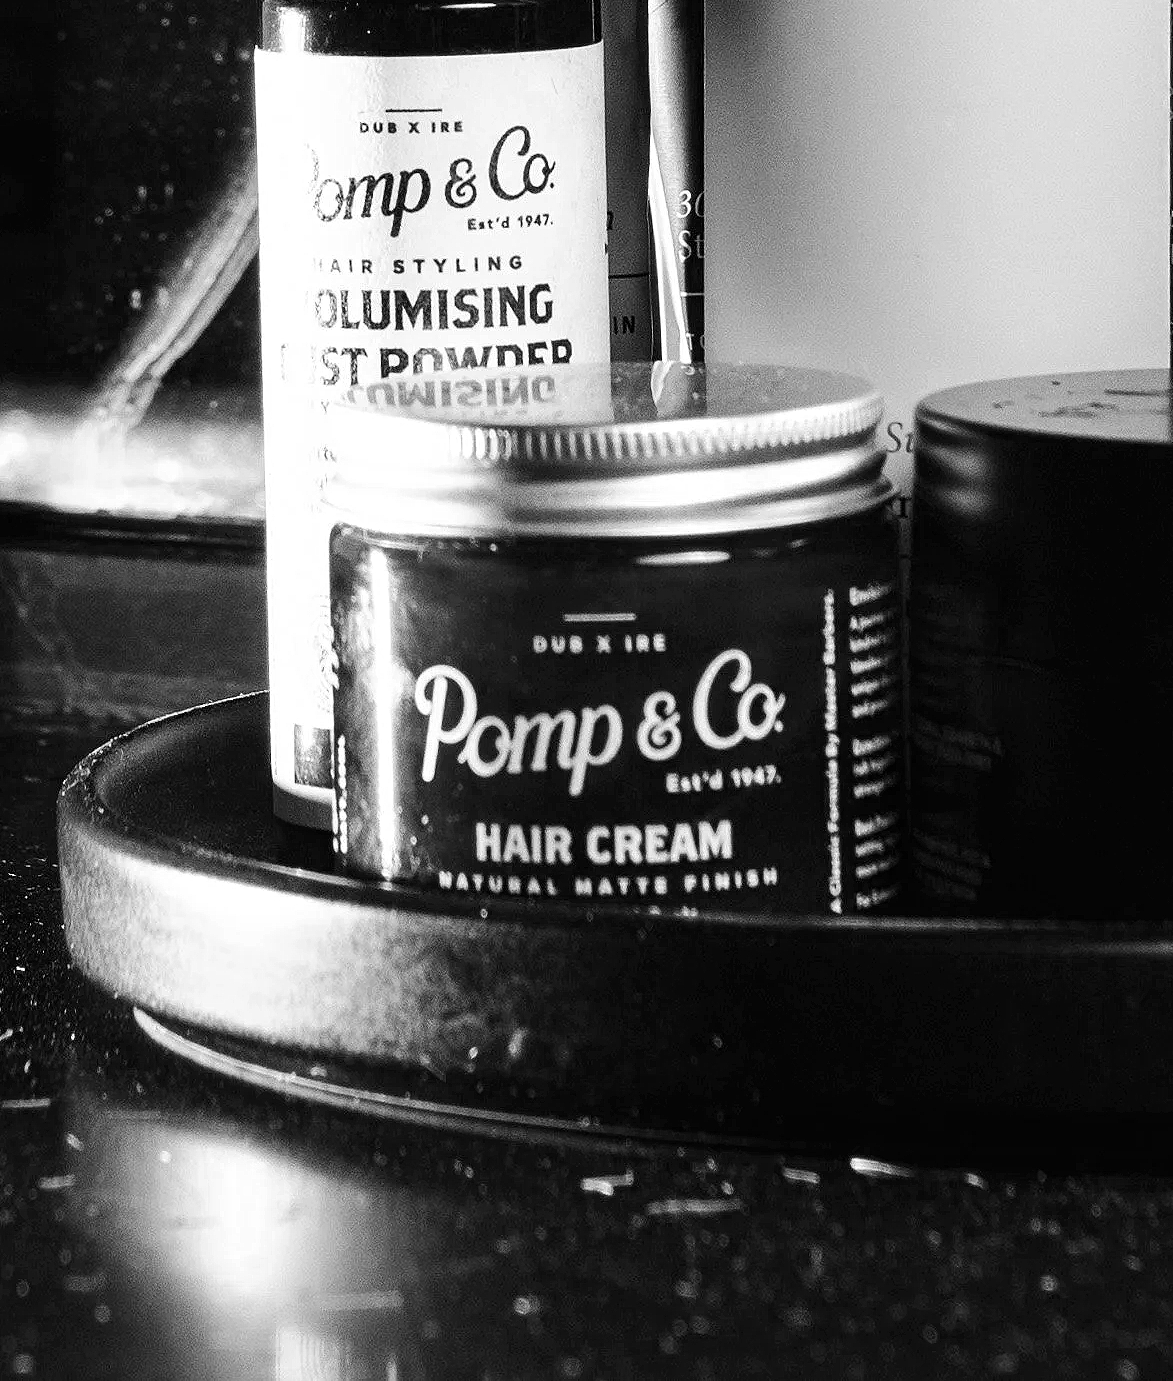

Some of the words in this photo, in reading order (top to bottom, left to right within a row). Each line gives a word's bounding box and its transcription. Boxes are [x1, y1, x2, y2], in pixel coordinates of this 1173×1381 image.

[359, 121, 397, 134] DUB
[408, 121, 421, 134] X
[431, 120, 465, 133] IRE
[305, 146, 432, 238] omp
[444, 157, 478, 209] &
[488, 124, 557, 201] Co.
[467, 216, 510, 232] Est'd
[517, 214, 554, 228] 1947.
[392, 255, 523, 275] STYLING
[305, 283, 554, 331] OLUMISING
[533, 634, 584, 653] DUB
[597, 634, 612, 653] X
[624, 633, 667, 653] IRE
[414, 664, 624, 798] Pomp
[636, 690, 683, 762] &
[692, 648, 787, 750] Co.
[475, 821, 573, 865] HAIR
[585, 818, 734, 865] CREAM
[438, 869, 558, 896] NATURAL
[574, 875, 669, 897] MATTE
[684, 866, 779, 894] FINISH
